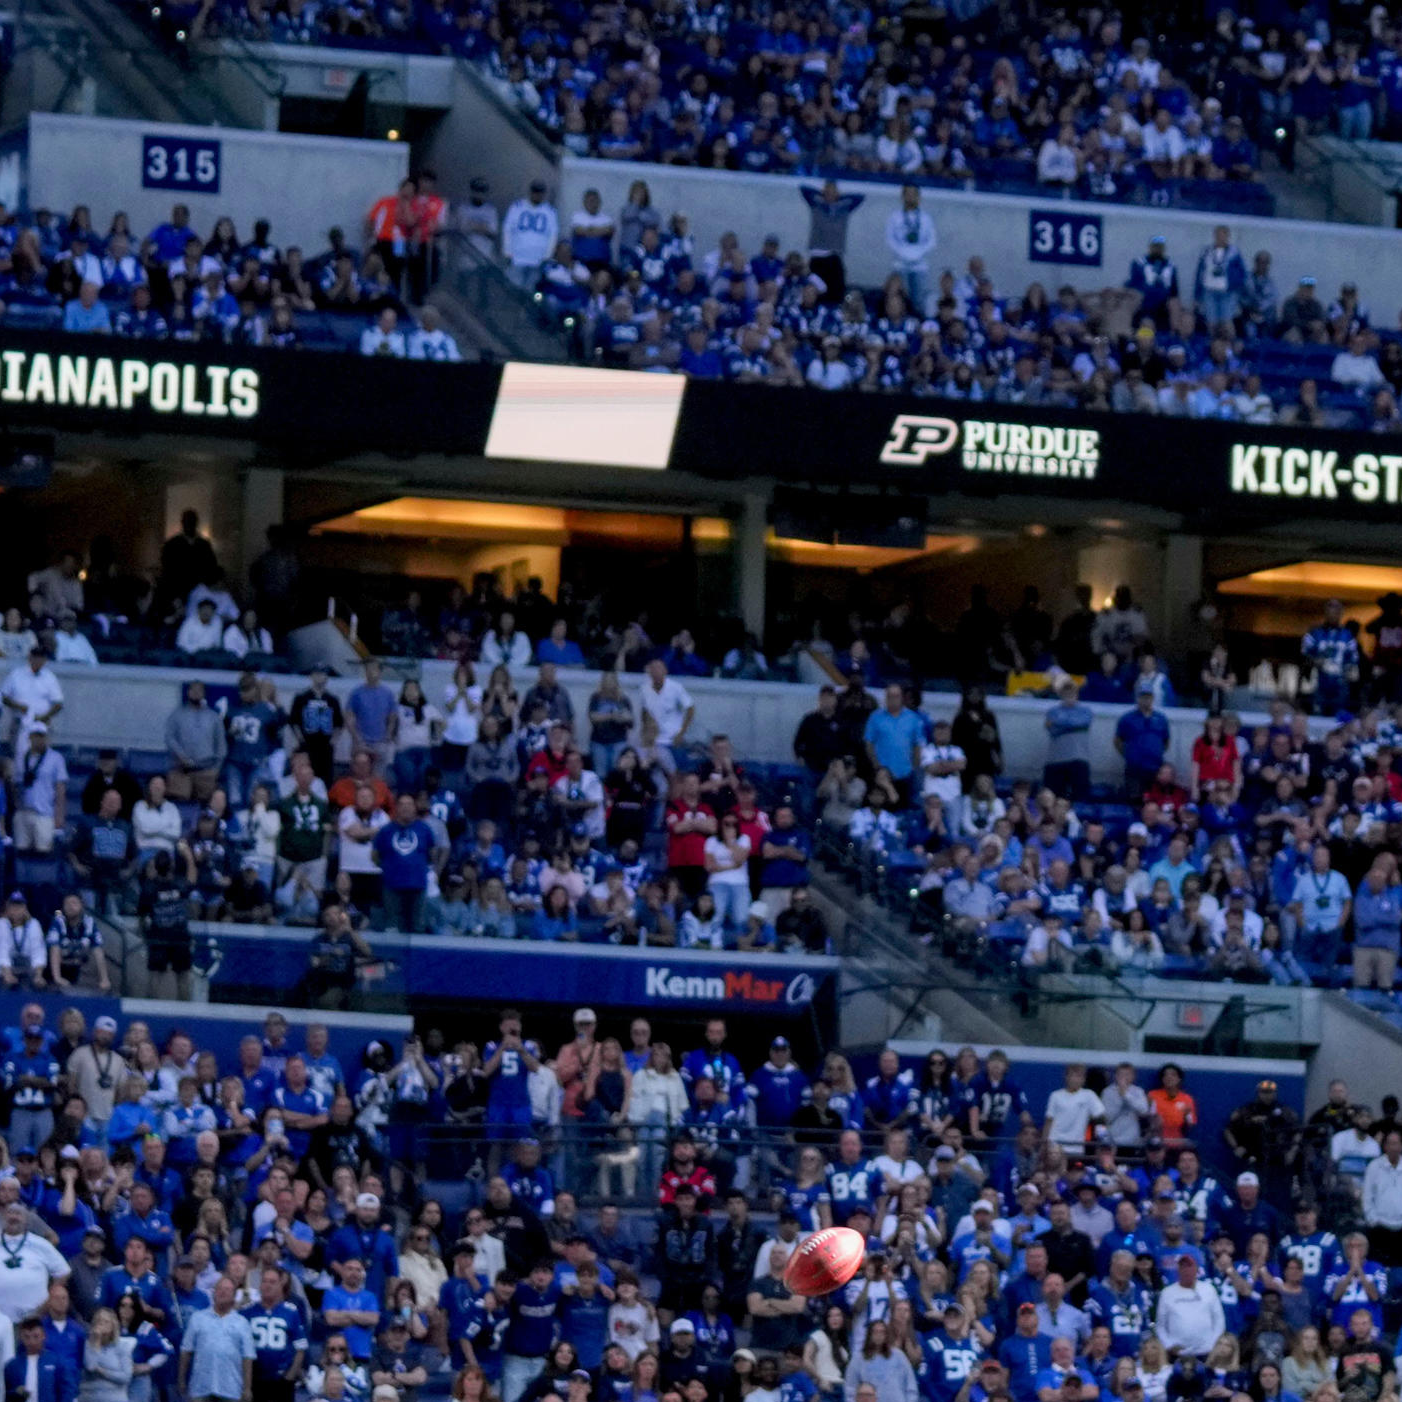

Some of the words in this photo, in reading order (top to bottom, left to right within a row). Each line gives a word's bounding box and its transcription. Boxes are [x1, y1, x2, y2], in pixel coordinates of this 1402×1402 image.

[147, 145, 215, 182] 315
[1031, 217, 1100, 257] 316
[963, 420, 1099, 458] PURDUE
[963, 449, 1098, 479] UNIVERSITY
[647, 966, 783, 1001] KennMar
[831, 1173, 868, 1201] 84
